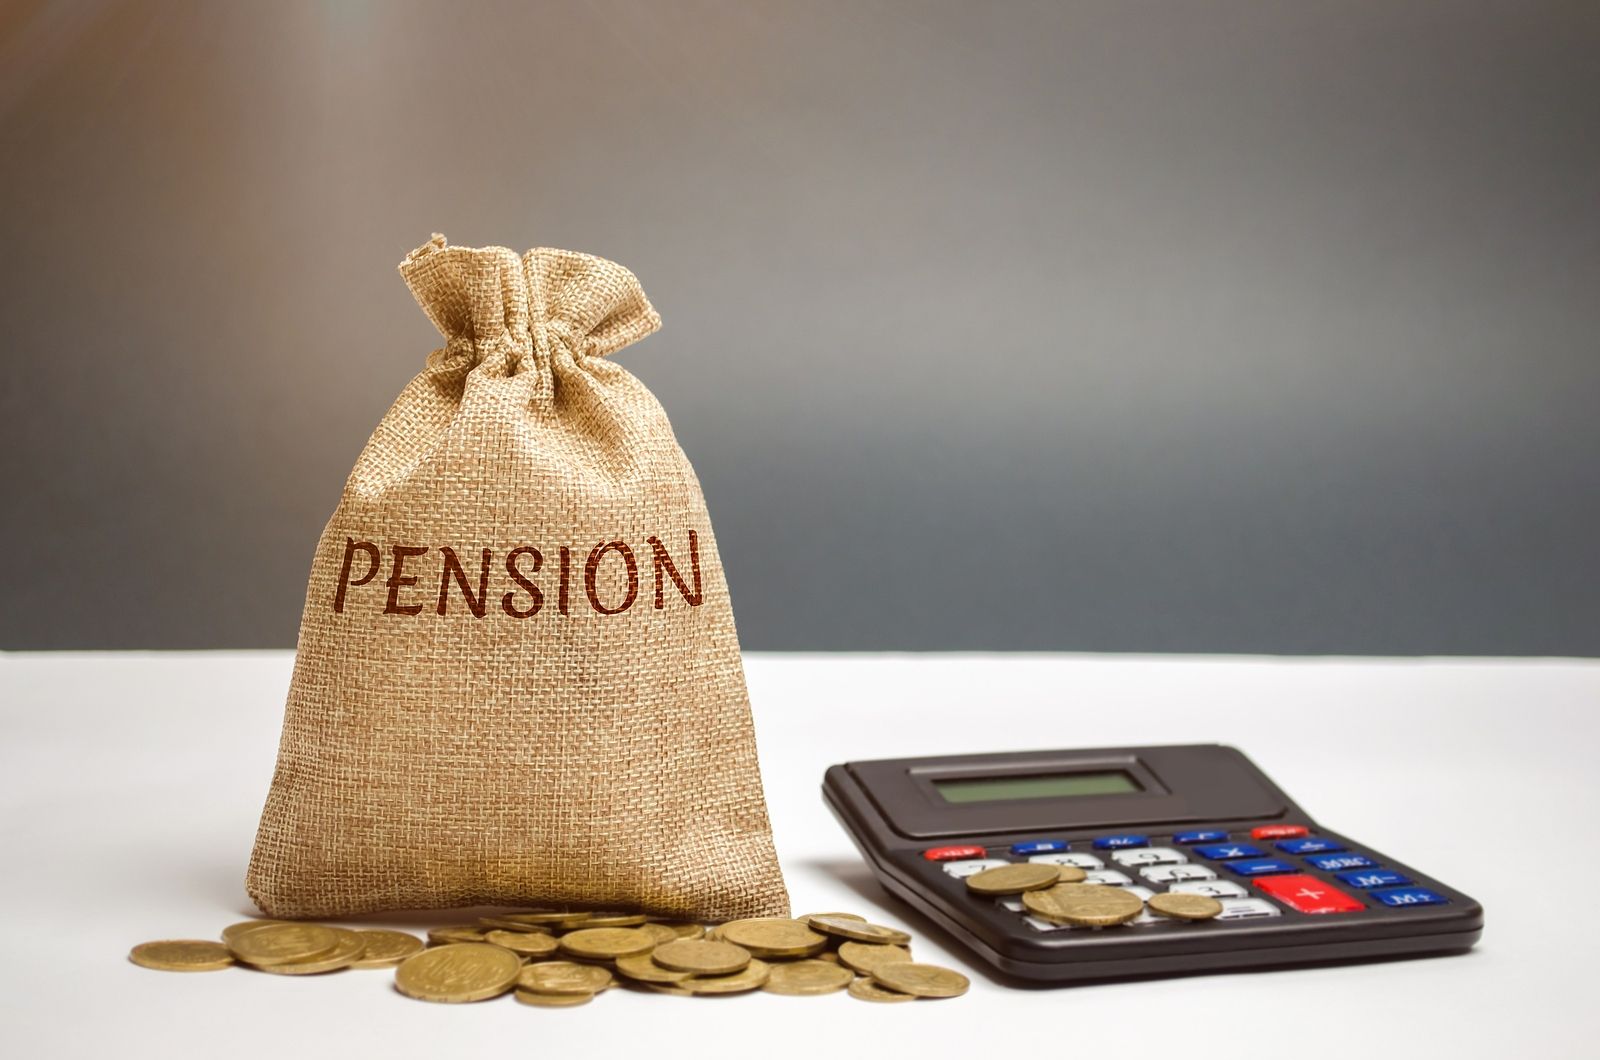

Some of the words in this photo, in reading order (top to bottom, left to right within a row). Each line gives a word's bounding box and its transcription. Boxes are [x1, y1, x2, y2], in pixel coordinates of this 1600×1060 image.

[334, 530, 704, 618] PENSION
[1319, 857, 1371, 869] MRC
[1391, 894, 1431, 905] M+
